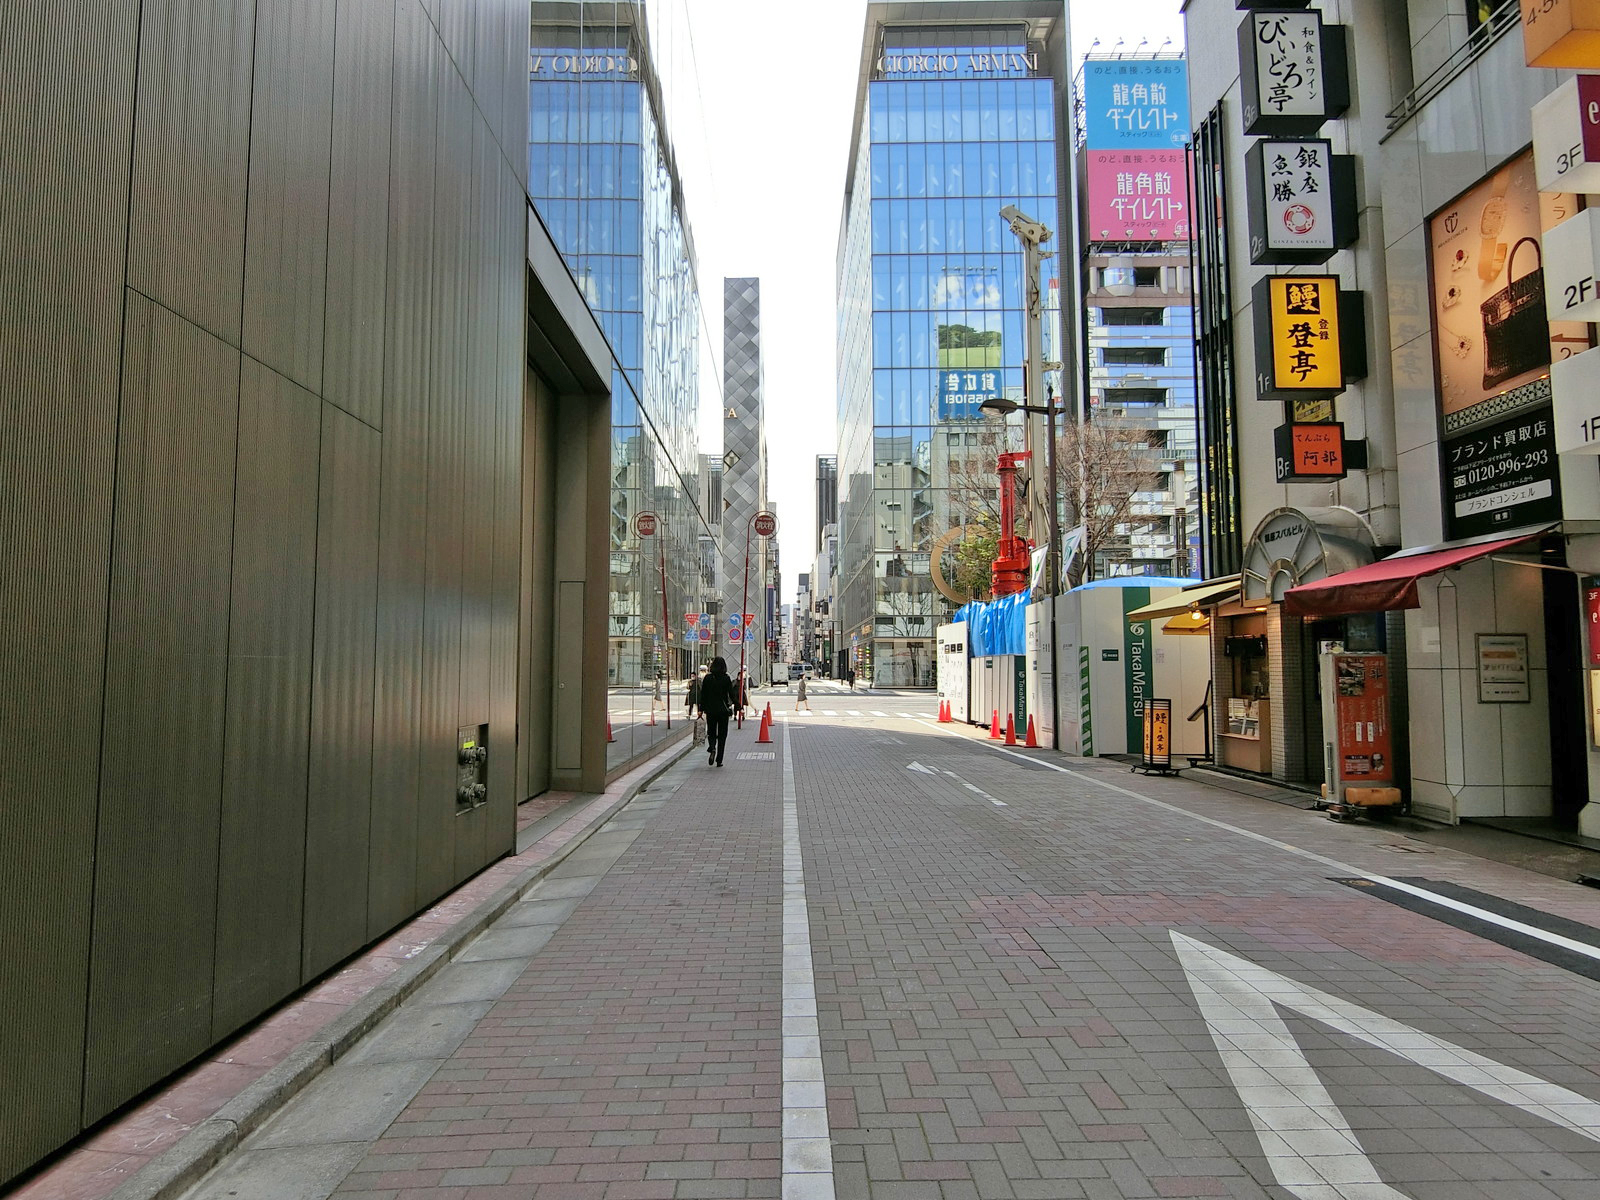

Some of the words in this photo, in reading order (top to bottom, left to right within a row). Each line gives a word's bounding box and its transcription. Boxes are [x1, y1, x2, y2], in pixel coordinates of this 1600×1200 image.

[877, 53, 958, 73] GIORGIO
[964, 53, 1039, 73] ARMANI
[1301, 27, 1317, 101] 和食&ワイン
[1112, 82, 1167, 106] 龍角散
[1106, 108, 1179, 130] ダイレクト
[1244, 105, 1256, 128] 3F
[1294, 146, 1321, 194] 銀座
[1556, 142, 1583, 176] 3F
[1116, 172, 1172, 195] 龍角散
[1270, 154, 1296, 202] 魚勝
[1110, 197, 1183, 220] ダイレクト
[1251, 235, 1264, 259] 2F
[1288, 284, 1320, 312] 鰻
[1564, 275, 1594, 310] 2F
[1318, 318, 1330, 340] 登録
[1286, 321, 1319, 382] 登亭
[1257, 372, 1271, 395] 1F
[1452, 420, 1547, 462] ブランド買取店
[1580, 419, 1600, 443] 1F
[1277, 457, 1290, 479] BF
[1303, 450, 1338, 466] 阿部
[1468, 449, 1548, 484] 0120-996-293
[1467, 487, 1536, 511] ブランドコンシェル
